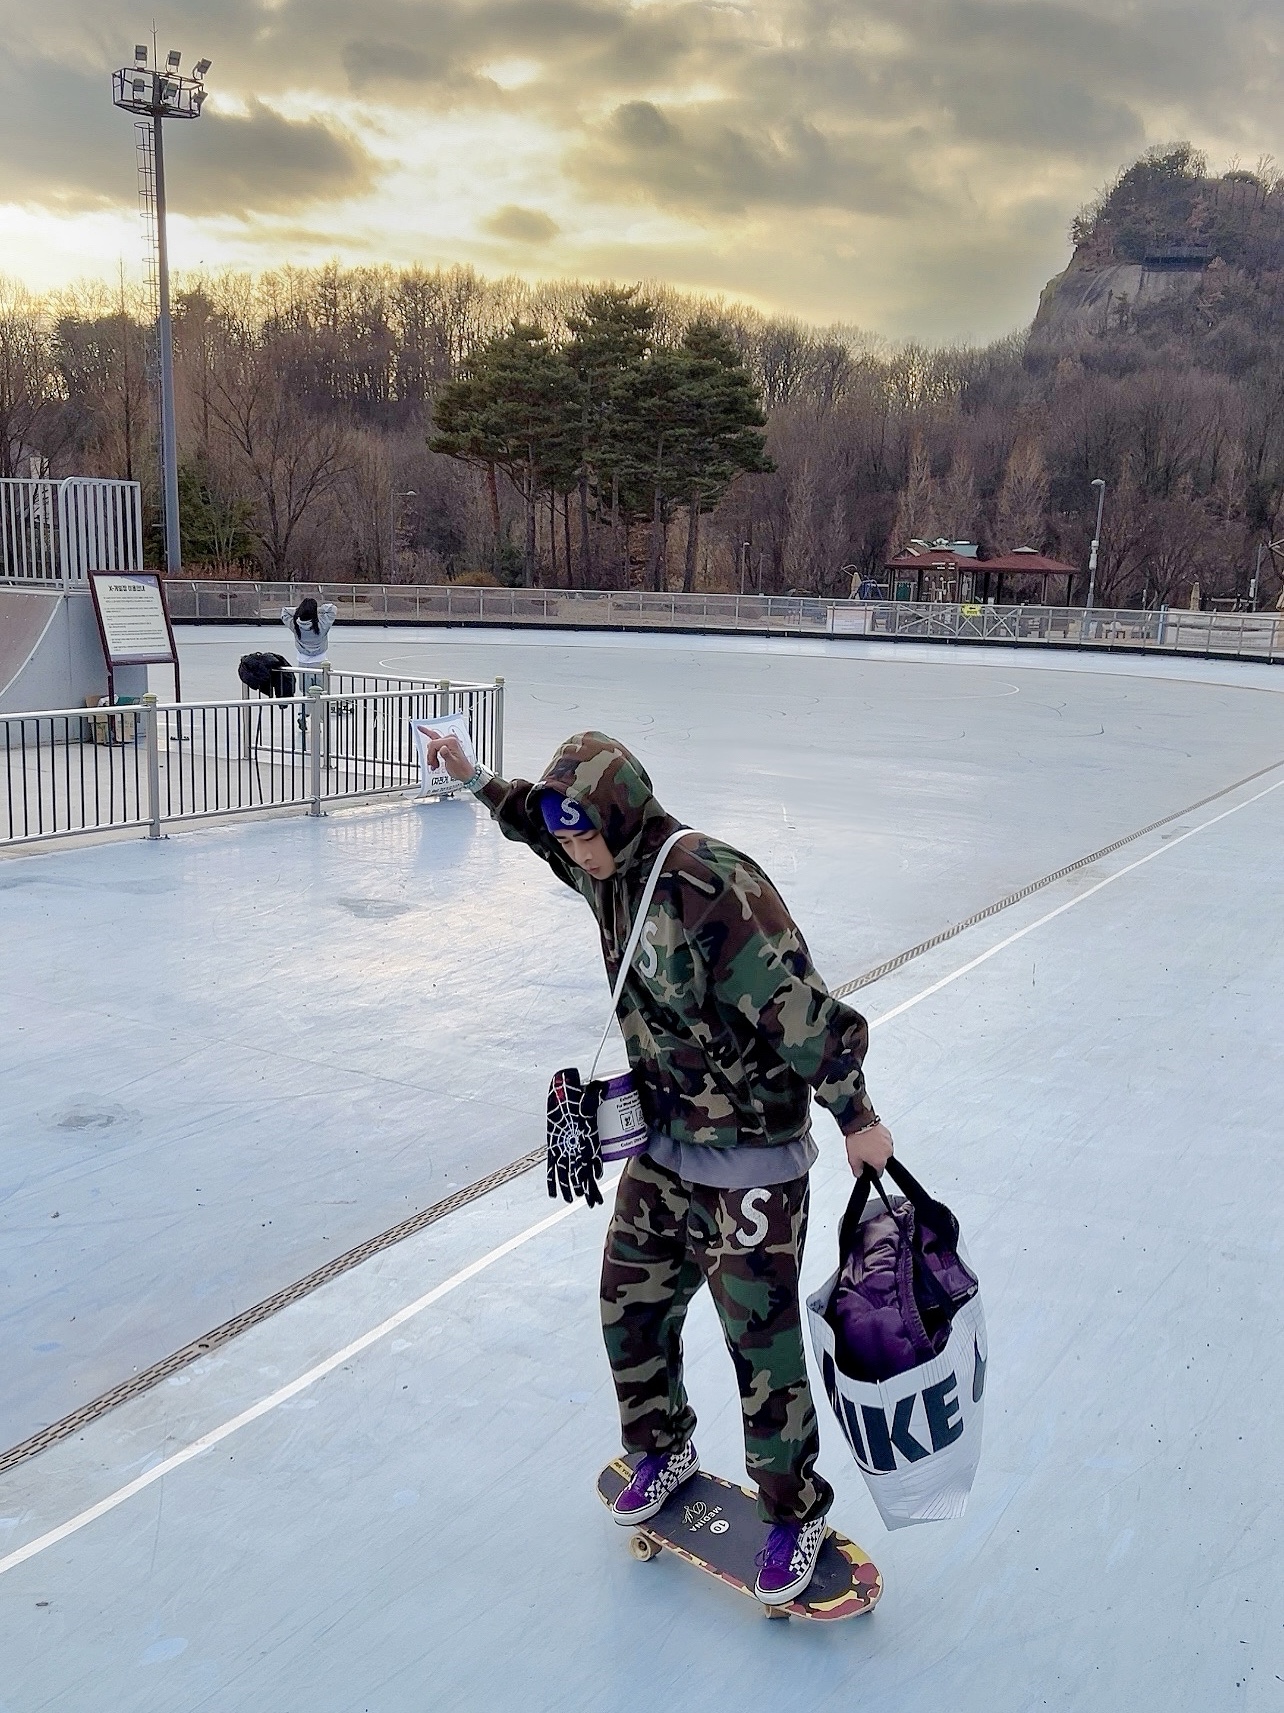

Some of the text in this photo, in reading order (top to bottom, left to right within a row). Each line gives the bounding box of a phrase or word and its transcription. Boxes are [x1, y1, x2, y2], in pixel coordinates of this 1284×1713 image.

[560, 797, 580, 826] S
[639, 920, 659, 978] S
[736, 1188, 772, 1247] S
[689, 1505, 723, 1532] MEDINA
[713, 1522, 726, 1532] 10
